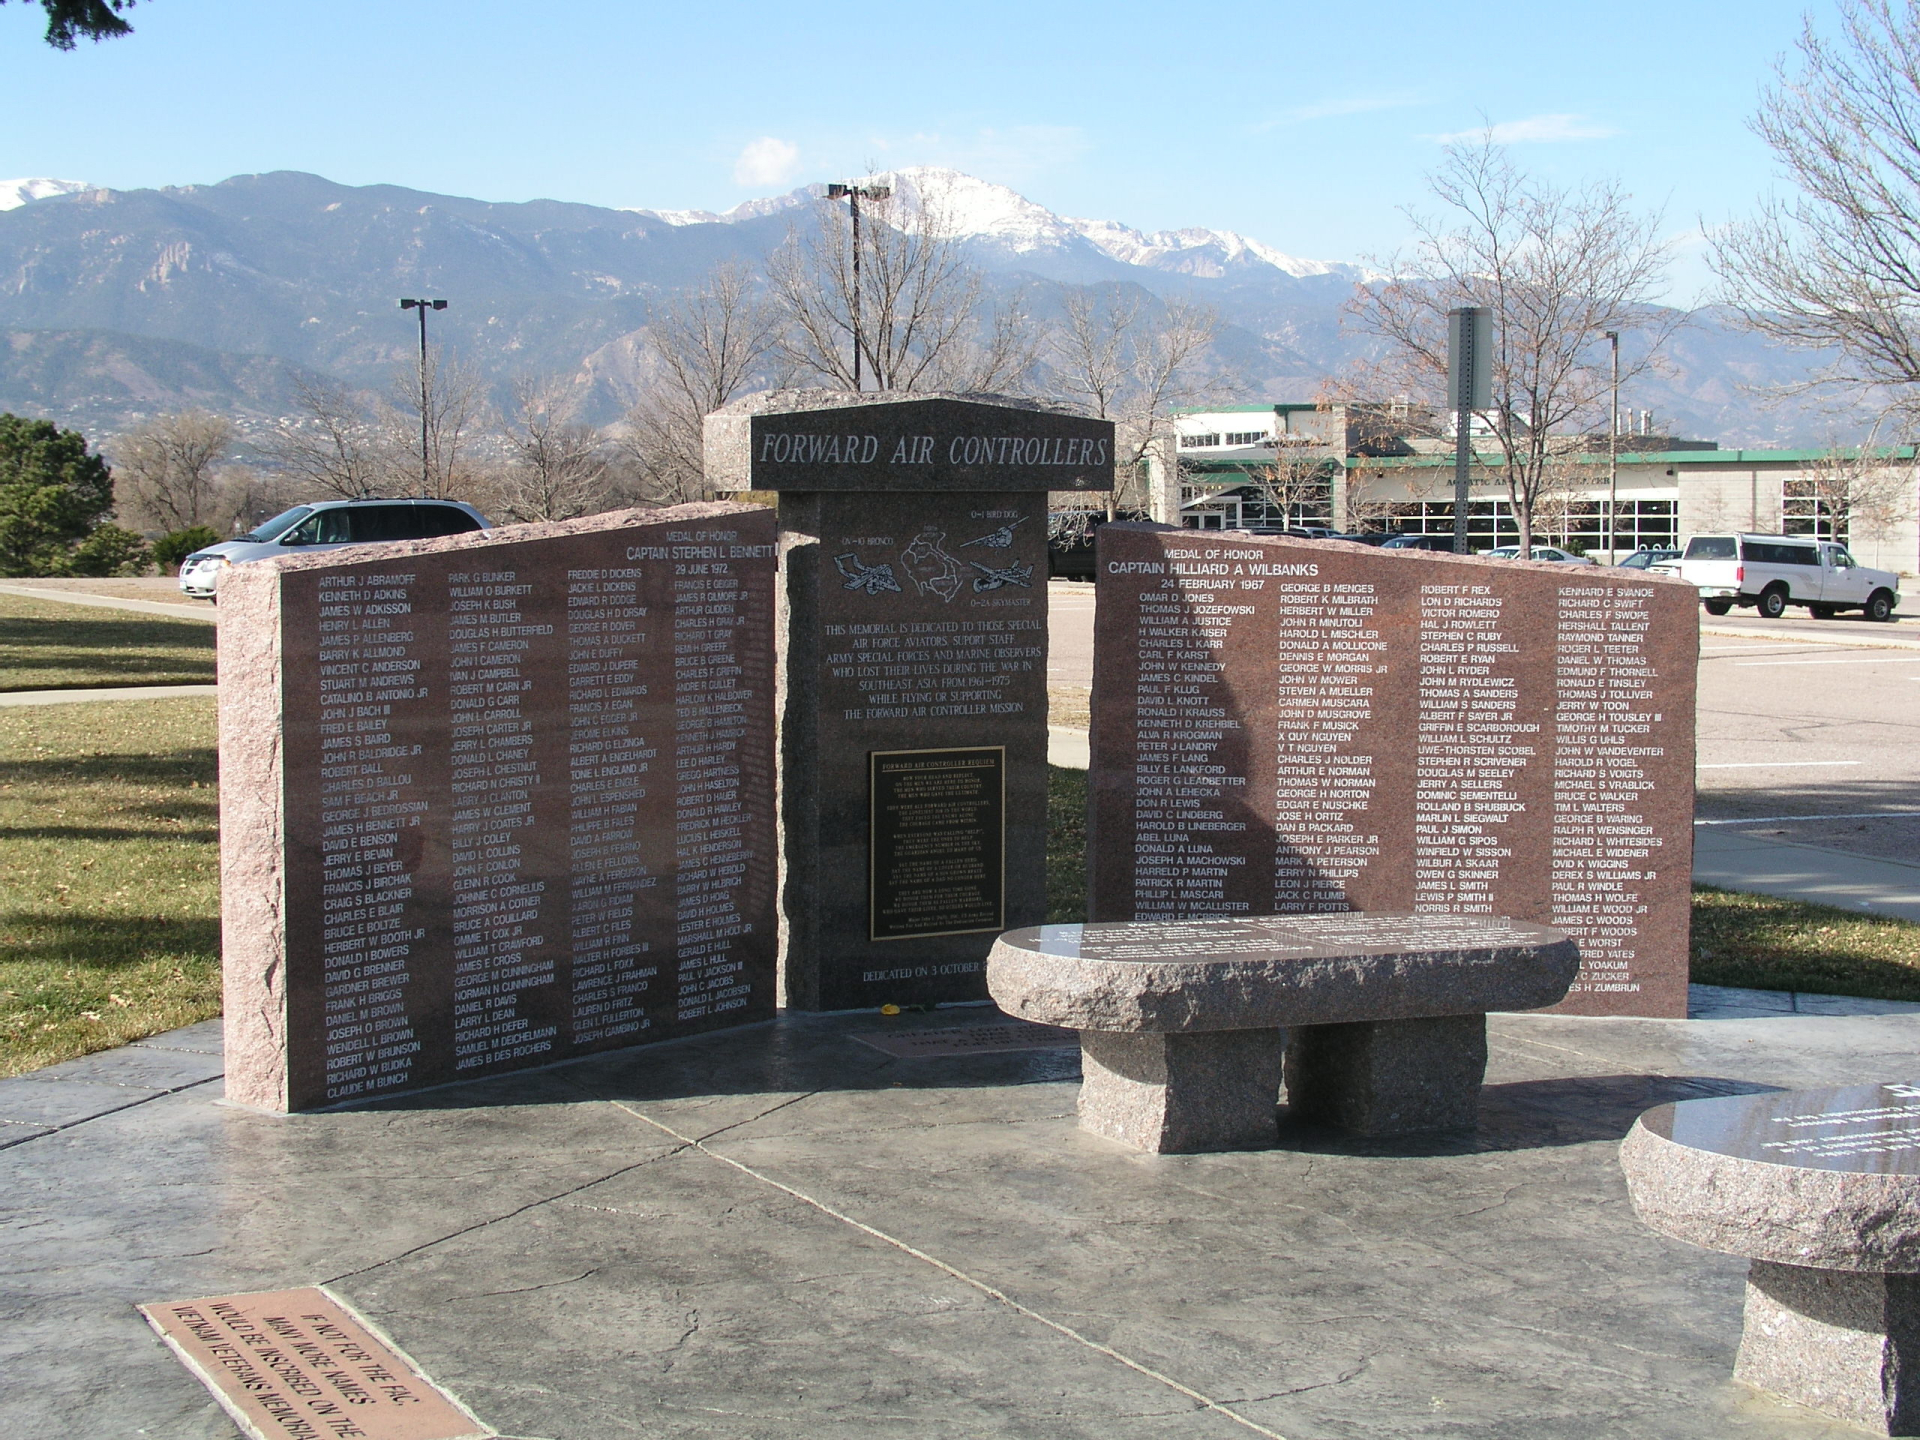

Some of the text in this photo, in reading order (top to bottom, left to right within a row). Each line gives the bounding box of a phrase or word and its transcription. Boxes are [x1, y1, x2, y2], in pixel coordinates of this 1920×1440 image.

[759, 434, 1108, 466] FORWARD AIR CONTROLLERS
[666, 531, 737, 541] MEDAL OF HONOR
[626, 545, 773, 561] CAPTAIN STEPHEN L BENNETT
[1164, 550, 1263, 560] MEDAL OF HONOR
[568, 569, 642, 580] FREDDIE D DICKENS
[675, 563, 728, 575] 29 JUNE 1972
[1109, 562, 1318, 576] CAPTAIN HILLIARD A WILBANKS
[319, 574, 415, 588] ARTHUR J ABRAMOFF
[1161, 579, 1264, 590] 24 FEBRUARY 1967
[450, 585, 532, 598] WILLIAM O BURKETT
[1280, 583, 1374, 593] GEORGE B MENGES
[1421, 585, 1490, 595] ROBERT F REX
[1558, 587, 1654, 597] KENNARD E SVANOE
[1139, 593, 1214, 603] OMAR D JONES
[319, 603, 411, 617] JAMES W ADKISSON
[1140, 604, 1255, 615] THOMAS J JOZEFOWSKI
[1421, 609, 1500, 618] VICTOR ROMERO
[825, 620, 1042, 635] THIS MEMORIAL IS DEDICATED TO THOSE SPECIAL
[852, 639, 868, 649] AIR
[872, 638, 900, 648] FORCE
[826, 647, 1042, 664] ARMY SPECIAL FORCES AND MARINE OBSERVERS
[675, 667, 742, 680] CHARLES F GRIFFIN
[832, 661, 1032, 677] WHO LOST THEIR LIVES DURING THE WAR IN
[858, 680, 913, 691] SOUTHEAST
[917, 678, 938, 689] ASIA
[941, 678, 966, 688] FROM
[868, 690, 1002, 704] WHILE FLYING OR SUPPORTING
[843, 703, 1023, 720] THE FORWARD AIR CONTROLLER MISSION
[882, 761, 912, 770] FORWARD
[914, 761, 925, 769] AIR
[927, 759, 966, 768] CONTROLLER
[1276, 812, 1343, 821] JOSE H ORTIZ
[1136, 833, 1189, 842] ABEL LUNA
[1415, 870, 1499, 879] OWEN G SKINNER
[1135, 878, 1222, 888] PATRICK R MARTIN
[1552, 893, 1638, 903] THOMAS H WOLFE
[455, 953, 521, 974] JAMES E CROSS
[863, 968, 911, 982] DEDICATED
[915, 966, 929, 976] ON
[932, 965, 937, 975] 3
[940, 962, 980, 974] OCTOBER
[678, 998, 747, 1020] ROBERT L JOHNSON
[327, 1072, 408, 1098] CLAUDE M BUNCH
[300, 1314, 328, 1322] IF
[311, 1324, 351, 1341] NOT
[171, 1305, 225, 1342] VIETNAM
[208, 1342, 273, 1392] VETERANS
[333, 1342, 372, 1362] FOR
[262, 1316, 377, 1406] MANY MORE NAMES
[209, 1302, 367, 1439] WOULD BE INSCRIBED ON THE
[358, 1363, 396, 1383] THE
